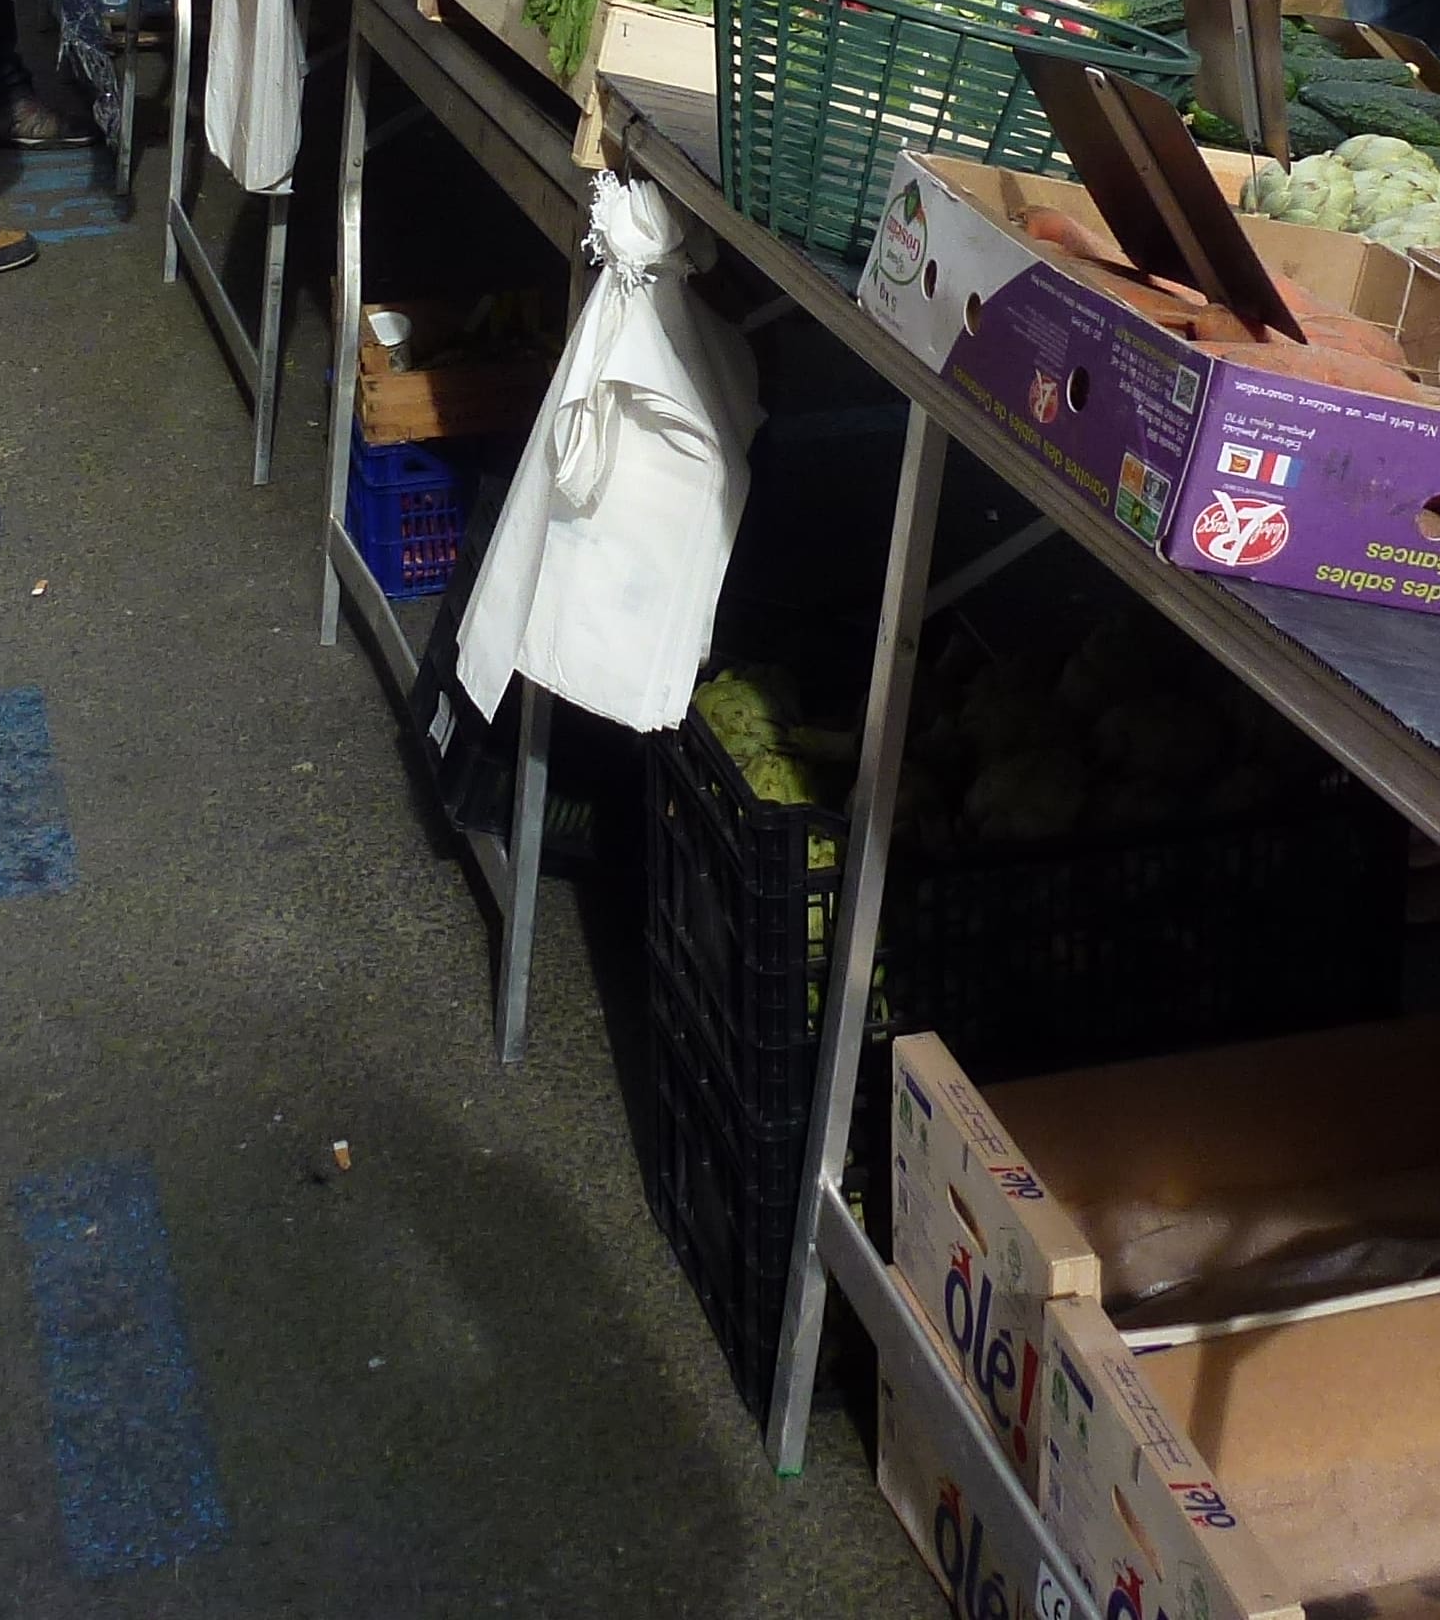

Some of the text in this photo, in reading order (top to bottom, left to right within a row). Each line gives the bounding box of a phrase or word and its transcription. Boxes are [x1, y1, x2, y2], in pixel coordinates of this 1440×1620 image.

[1042, 439, 1064, 468] des
[1064, 456, 1110, 508] Carottes
[1315, 564, 1396, 593] sables
